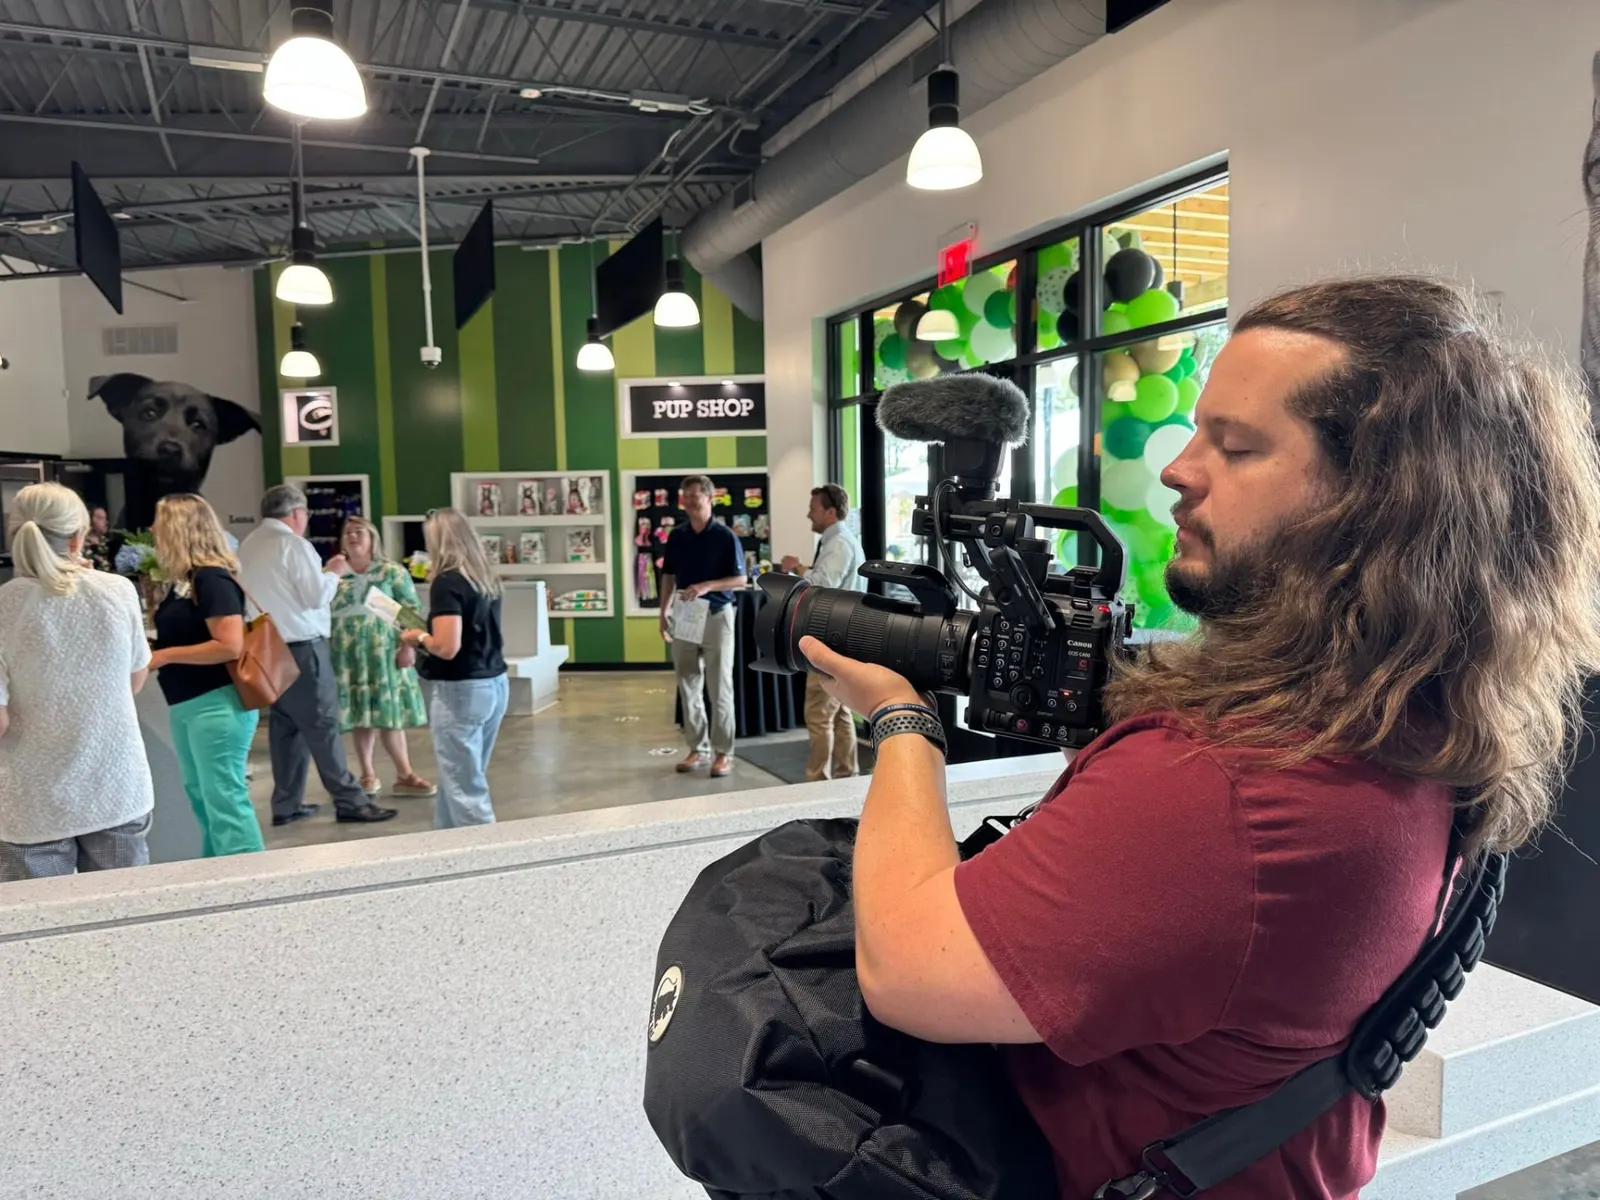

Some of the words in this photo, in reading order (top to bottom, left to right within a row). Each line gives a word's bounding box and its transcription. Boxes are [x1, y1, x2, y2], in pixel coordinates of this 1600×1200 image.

[652, 400, 693, 419] PUP
[697, 398, 754, 418] SHOP
[1067, 640, 1092, 649] Canon
